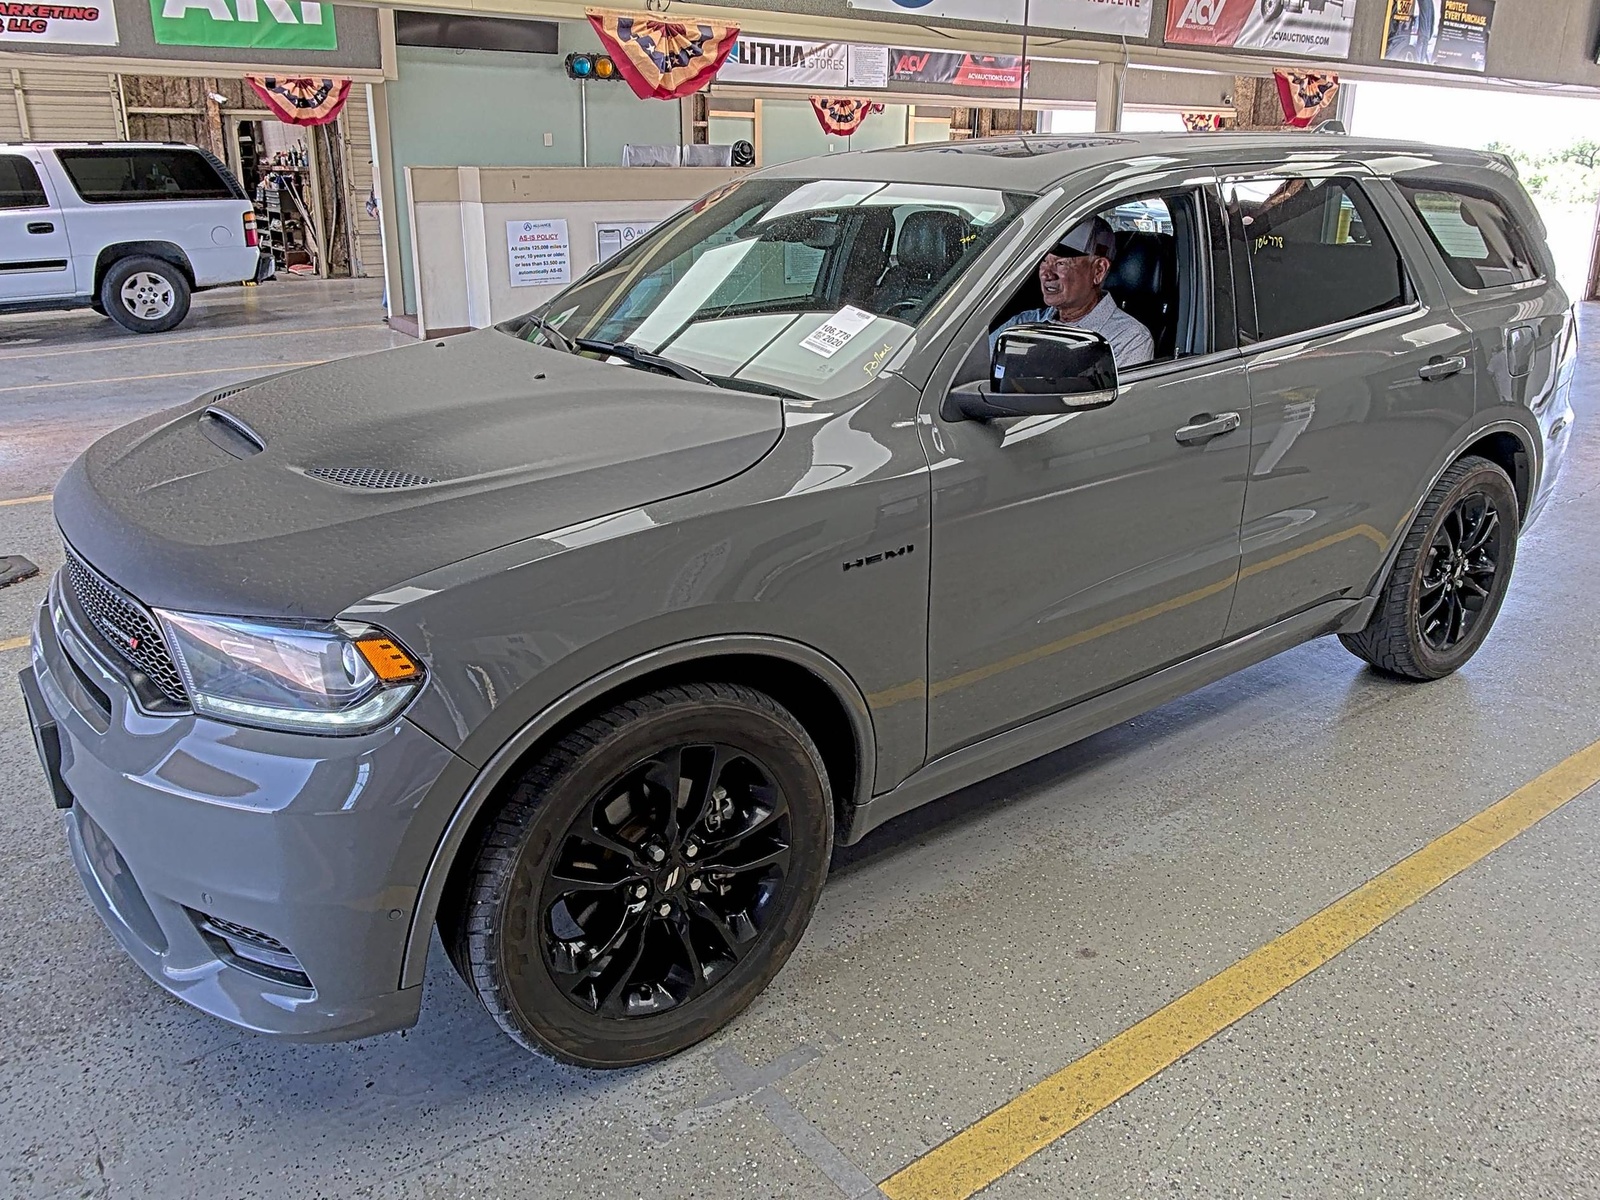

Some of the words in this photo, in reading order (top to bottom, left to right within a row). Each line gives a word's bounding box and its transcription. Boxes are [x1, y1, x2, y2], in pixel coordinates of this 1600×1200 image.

[1445, 1, 1469, 12] PROTECT
[1444, 10, 1461, 21] EVERY
[7, 18, 47, 33] LLC
[739, 41, 806, 68] LITHIA
[809, 47, 834, 58] AUTO
[808, 57, 845, 71] STORES
[895, 53, 930, 74] ACV
[967, 72, 1016, 83] ACVAUCTIONS.COM
[821, 324, 852, 341] 106,778
[822, 335, 844, 347] 2020
[842, 544, 914, 572] HEMI
